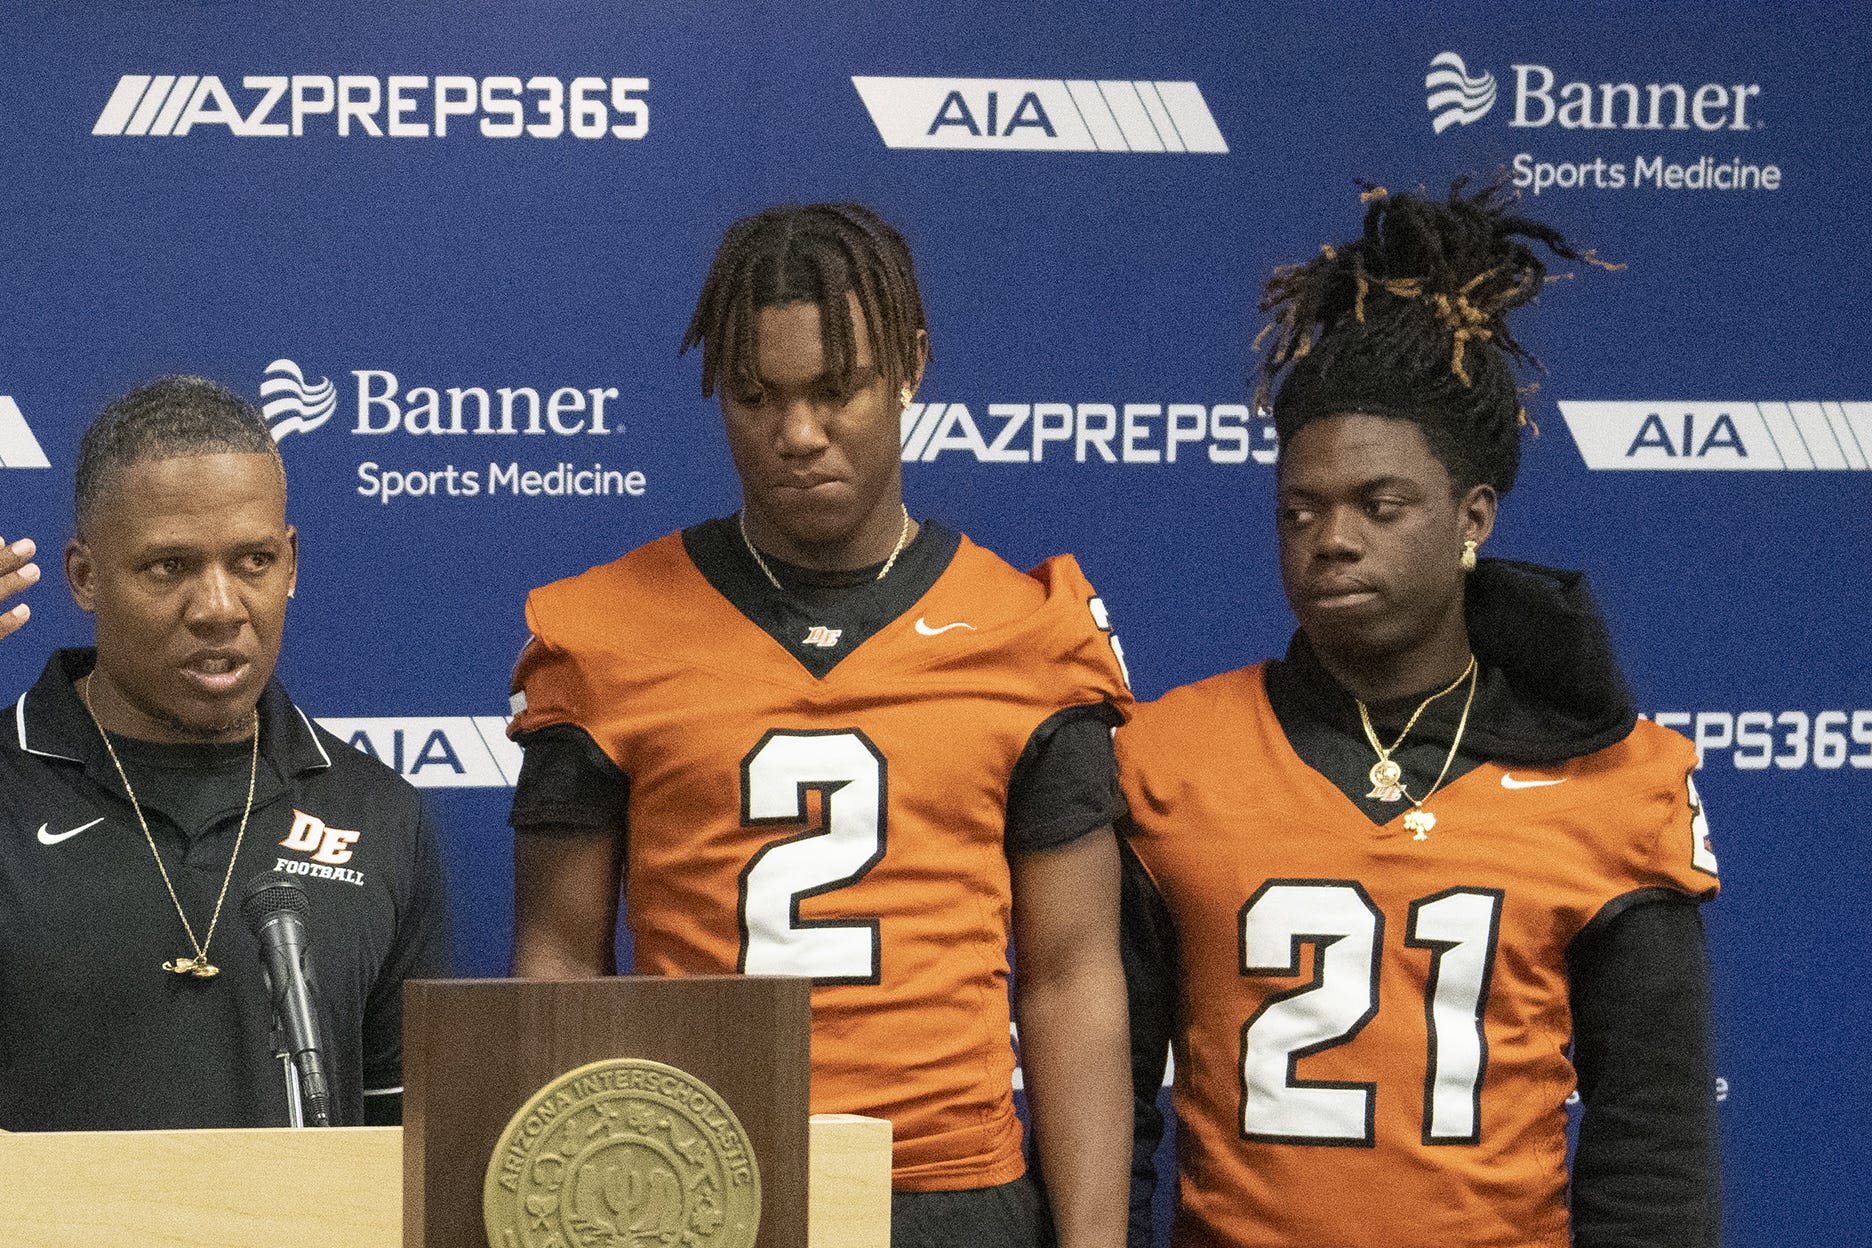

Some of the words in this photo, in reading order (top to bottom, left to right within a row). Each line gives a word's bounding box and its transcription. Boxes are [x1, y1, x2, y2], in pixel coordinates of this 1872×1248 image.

[172, 75, 650, 140] AZPREPS365
[927, 90, 1058, 138] AIA
[1508, 64, 1761, 132] Banner
[1512, 153, 1626, 194] Sports
[1633, 154, 1781, 192] Medicine
[351, 369, 619, 436] Banner
[1625, 413, 1749, 459] AIA
[357, 461, 480, 503] Sports
[488, 462, 647, 497] Medicine
[277, 807, 361, 865] DE
[739, 727, 888, 985] 2
[273, 857, 365, 887] FOOTBALL
[1238, 878, 1505, 1147] 21
[499, 1089, 576, 1193] ARIZONA
